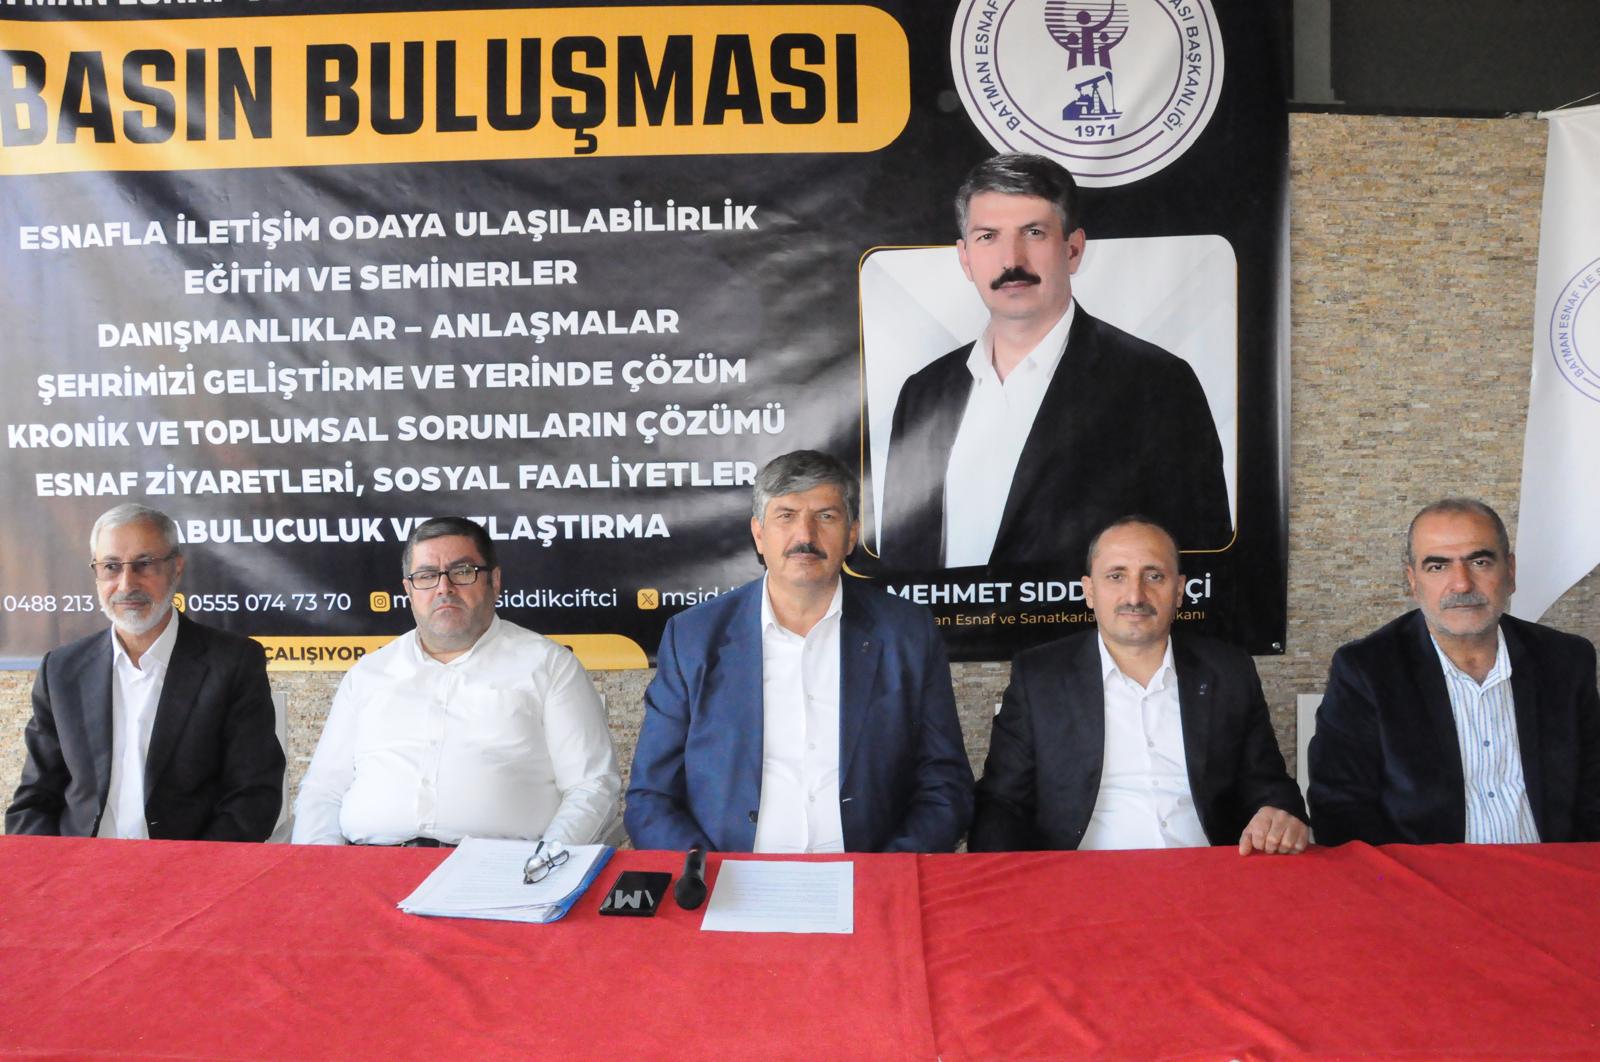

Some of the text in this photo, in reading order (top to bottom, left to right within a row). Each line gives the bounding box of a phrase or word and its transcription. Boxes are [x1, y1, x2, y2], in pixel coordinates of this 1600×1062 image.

[1169, 0, 1195, 21] ASI
[0, 33, 858, 155] BASIN BULUŞMASI
[975, 61, 1020, 131] BATMAN
[1163, 26, 1201, 131] BAŞKANLIĞI
[1074, 124, 1116, 137] 1971
[19, 198, 759, 250] ESNAFLA İLETİŞİM ODAYA ULAŞILABİLİRLİK
[184, 256, 578, 294] EĞİTİM VE SEMİNERLER
[1558, 290, 1580, 329] ESNAF
[98, 316, 397, 352] DANIŞMANLIKLAR
[430, 309, 680, 343] ANLAŞMALAR
[1558, 332, 1584, 378] BATMAN
[37, 353, 746, 405] ŞEHRİMİZİ GELİŞTİRME VE YERİNDE ÇÖZÜM
[7, 402, 785, 448] KRONİK VE TOPLUMSAL SORUNLARIN ÇÖZÜMÜ
[35, 455, 757, 497] ESNAF ZİYARETLERİ, SOSYAL FAALİYETLER
[390, 516, 433, 542] V
[466, 514, 670, 547] LAŞTIRMA
[3, 595, 94, 612] 0488 213
[188, 593, 352, 612] 0555 074 73 70
[886, 582, 1012, 604] MEHMET
[1020, 581, 1086, 603] SIDD
[956, 612, 997, 625] Esnaf
[1000, 614, 1016, 625] ve
[1020, 611, 1096, 625] Sanatkarla
